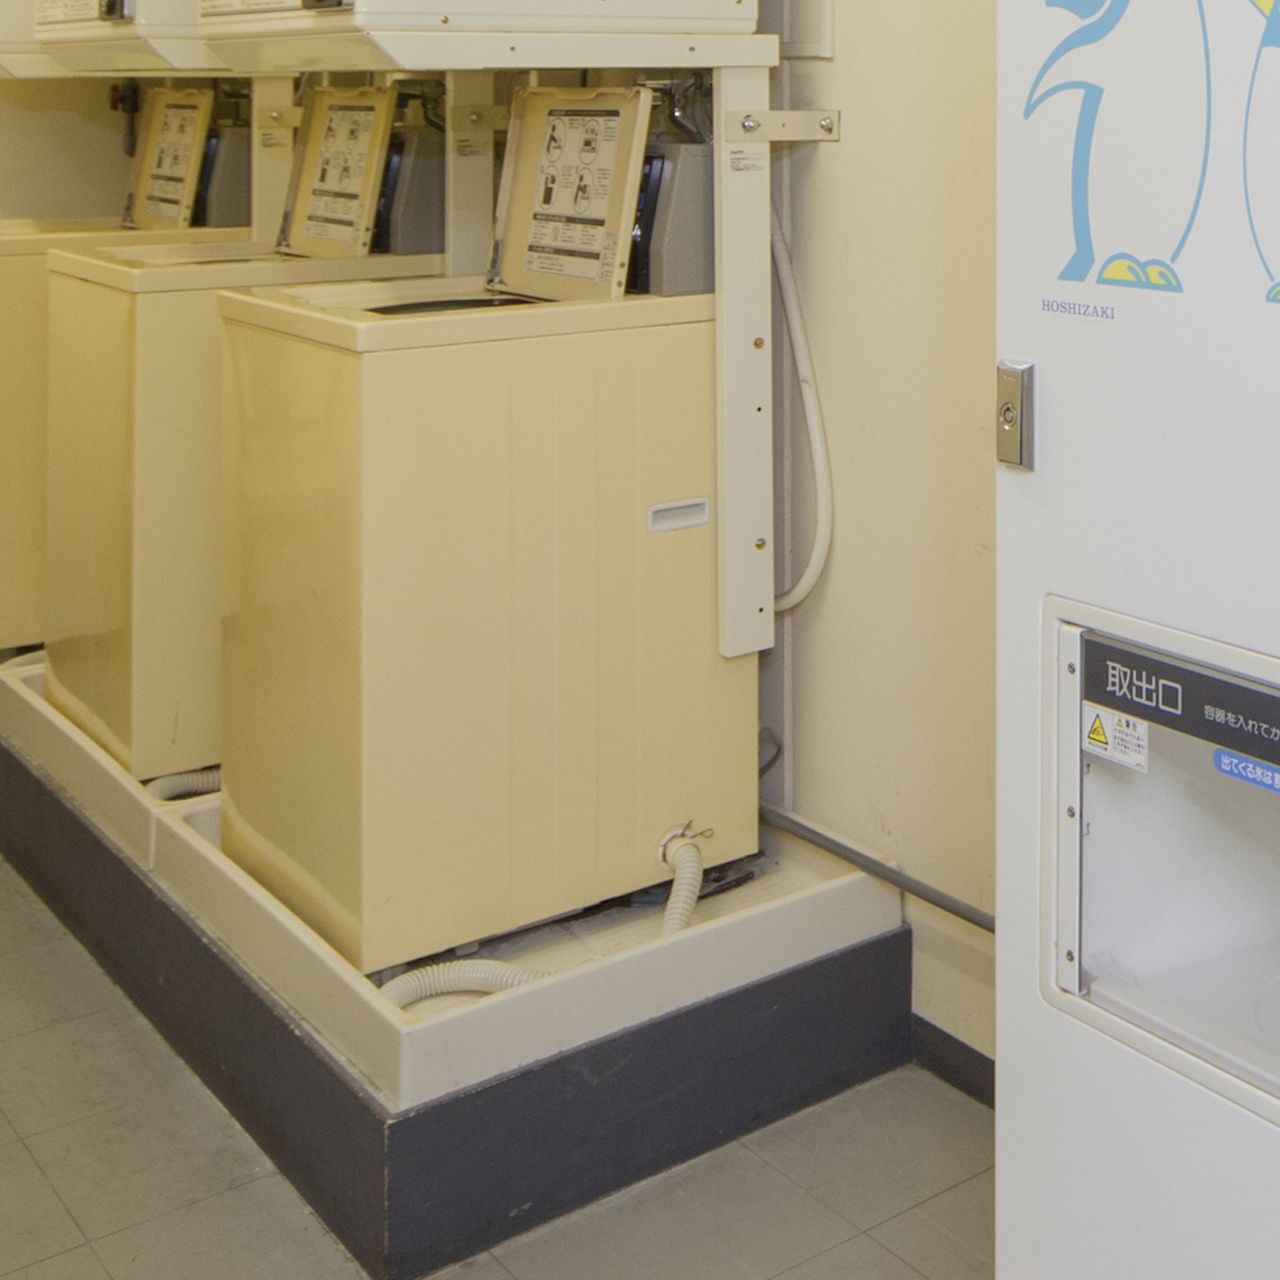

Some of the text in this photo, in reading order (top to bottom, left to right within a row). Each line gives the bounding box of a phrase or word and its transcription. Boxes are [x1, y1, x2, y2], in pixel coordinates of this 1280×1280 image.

[1041, 299, 1115, 320] HOSHIZAKI
[1106, 660, 1182, 716] 取出口
